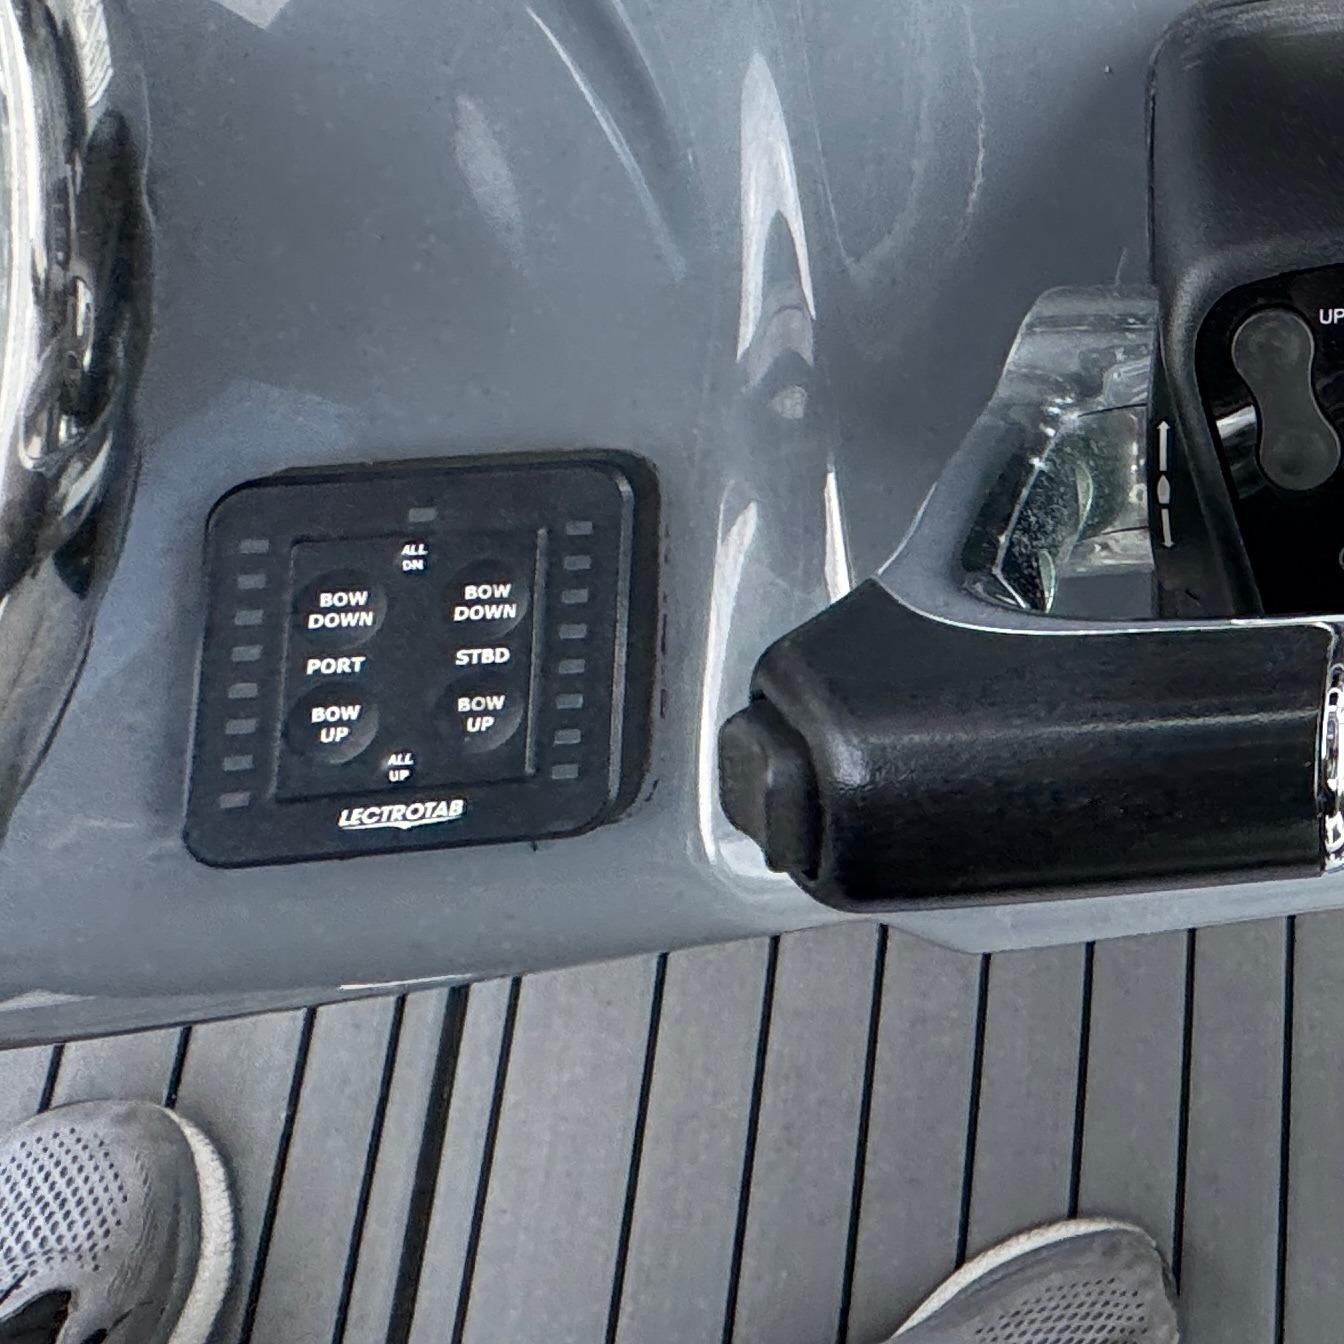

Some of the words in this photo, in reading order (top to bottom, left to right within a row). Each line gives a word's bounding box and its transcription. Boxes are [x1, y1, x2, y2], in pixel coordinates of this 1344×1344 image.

[400, 542, 429, 556] ALL
[401, 559, 425, 572] DN
[319, 590, 369, 609] BOW
[463, 582, 513, 601] BOW
[306, 610, 374, 630] DOWN
[452, 602, 518, 622] DOWN
[454, 646, 511, 666] STBD
[305, 656, 366, 676] PORT
[310, 703, 362, 724] BOW
[456, 694, 506, 714] BOW
[465, 715, 495, 734] UP
[319, 725, 350, 744] UP
[386, 752, 415, 767] ALL
[387, 768, 411, 782] UP
[337, 798, 466, 829] LECTROTAB
